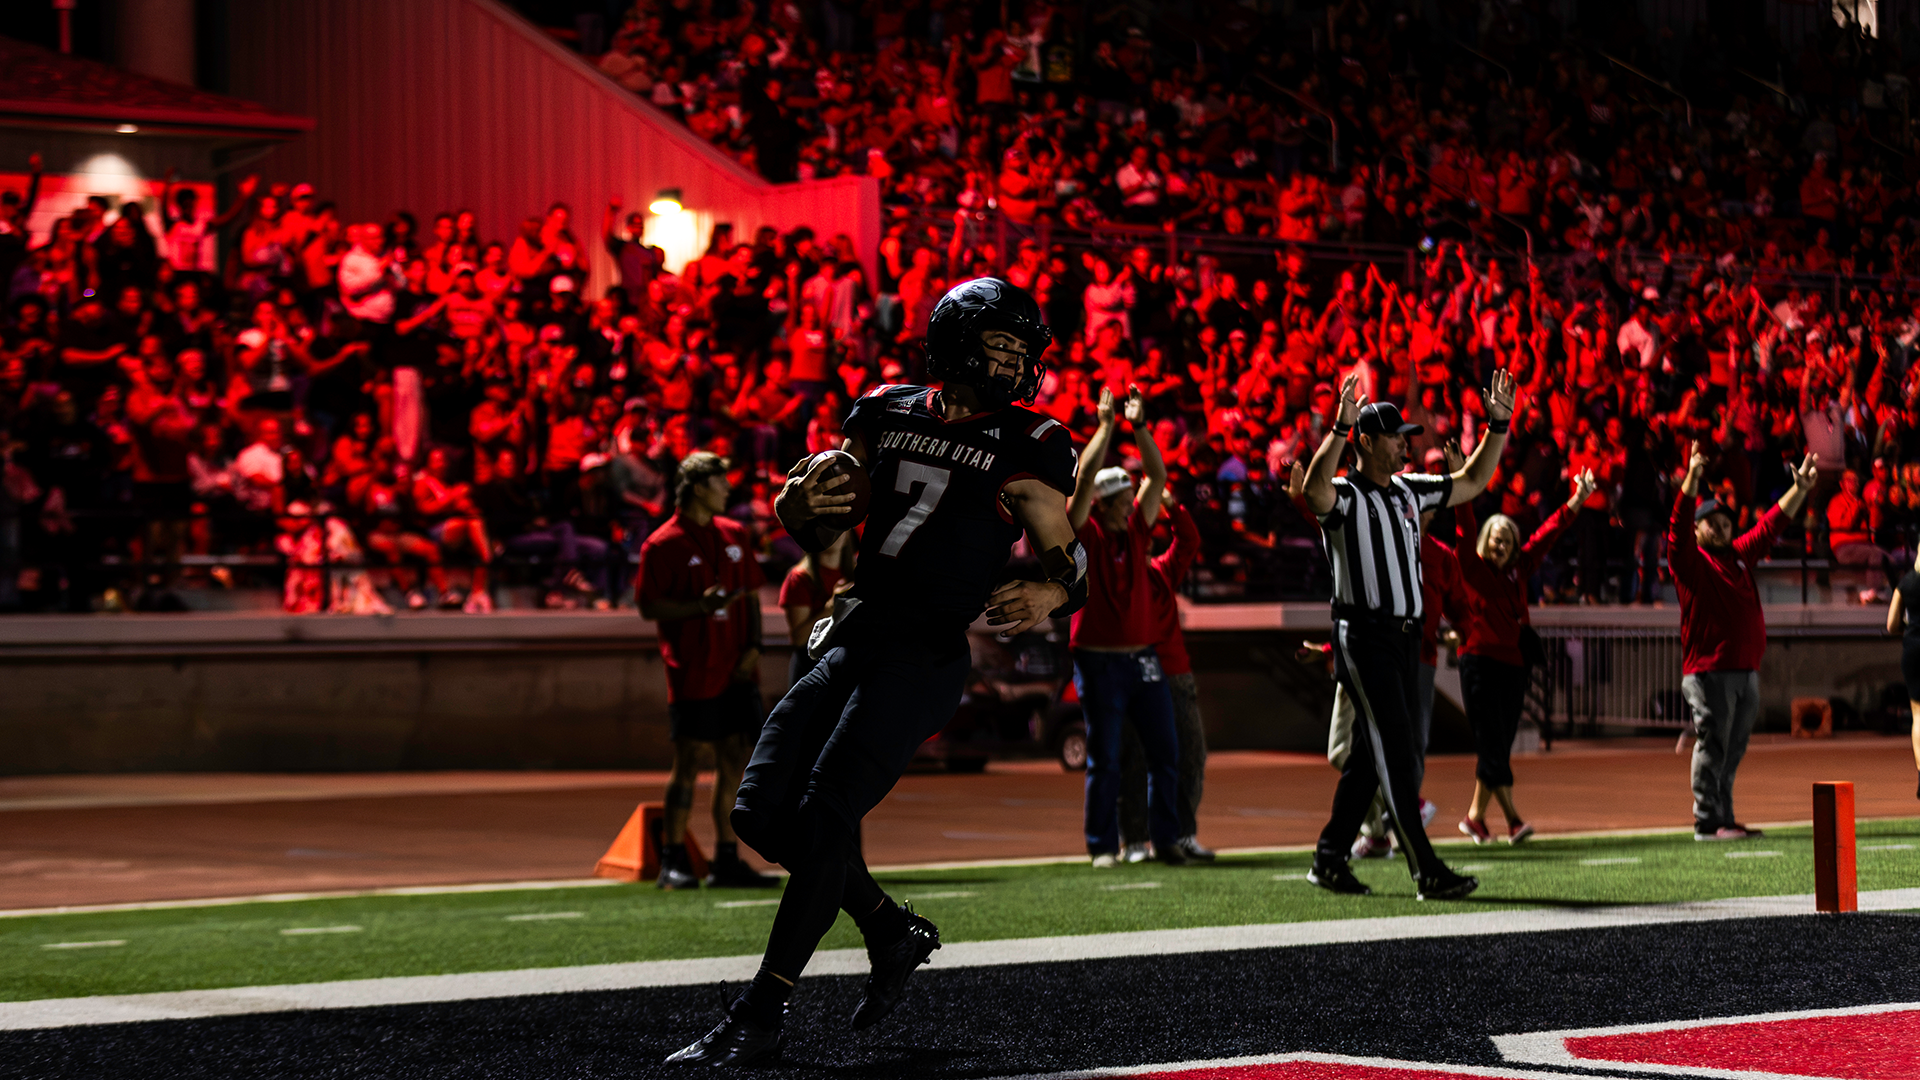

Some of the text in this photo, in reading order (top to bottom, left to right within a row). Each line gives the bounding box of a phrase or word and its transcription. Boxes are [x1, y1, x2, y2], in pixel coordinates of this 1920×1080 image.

[876, 430, 996, 472] SOUTHERN UTAH
[877, 457, 953, 559] 7
